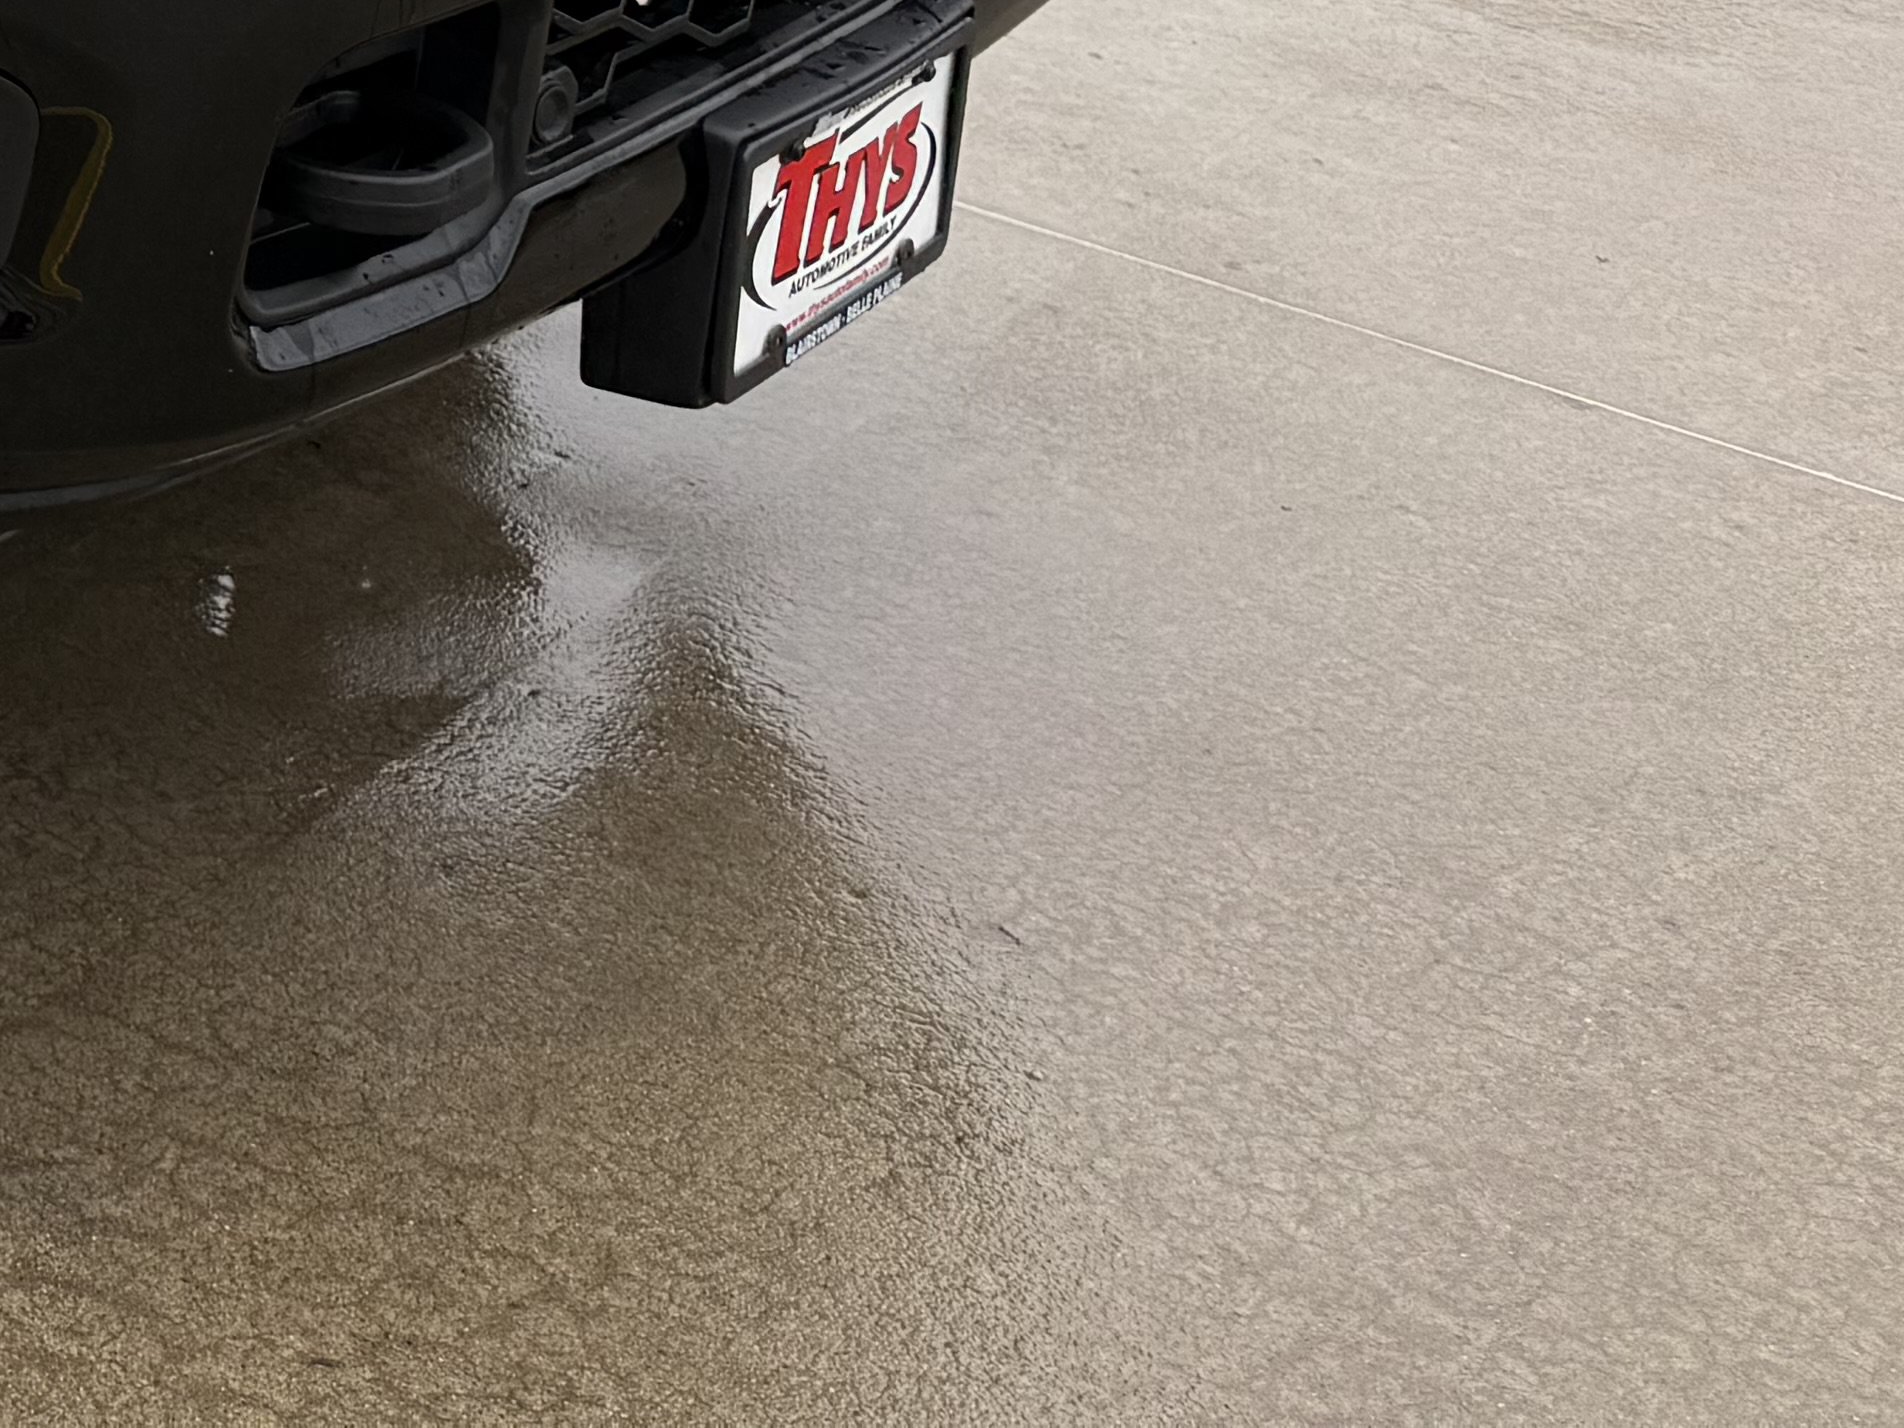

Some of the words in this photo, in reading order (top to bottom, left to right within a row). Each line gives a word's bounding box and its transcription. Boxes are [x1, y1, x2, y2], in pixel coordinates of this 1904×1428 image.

[772, 100, 924, 286] THYS
[788, 239, 860, 298] AUTOMOTIVE
[861, 216, 897, 252] FAMILY
[845, 292, 874, 324] BELLE
